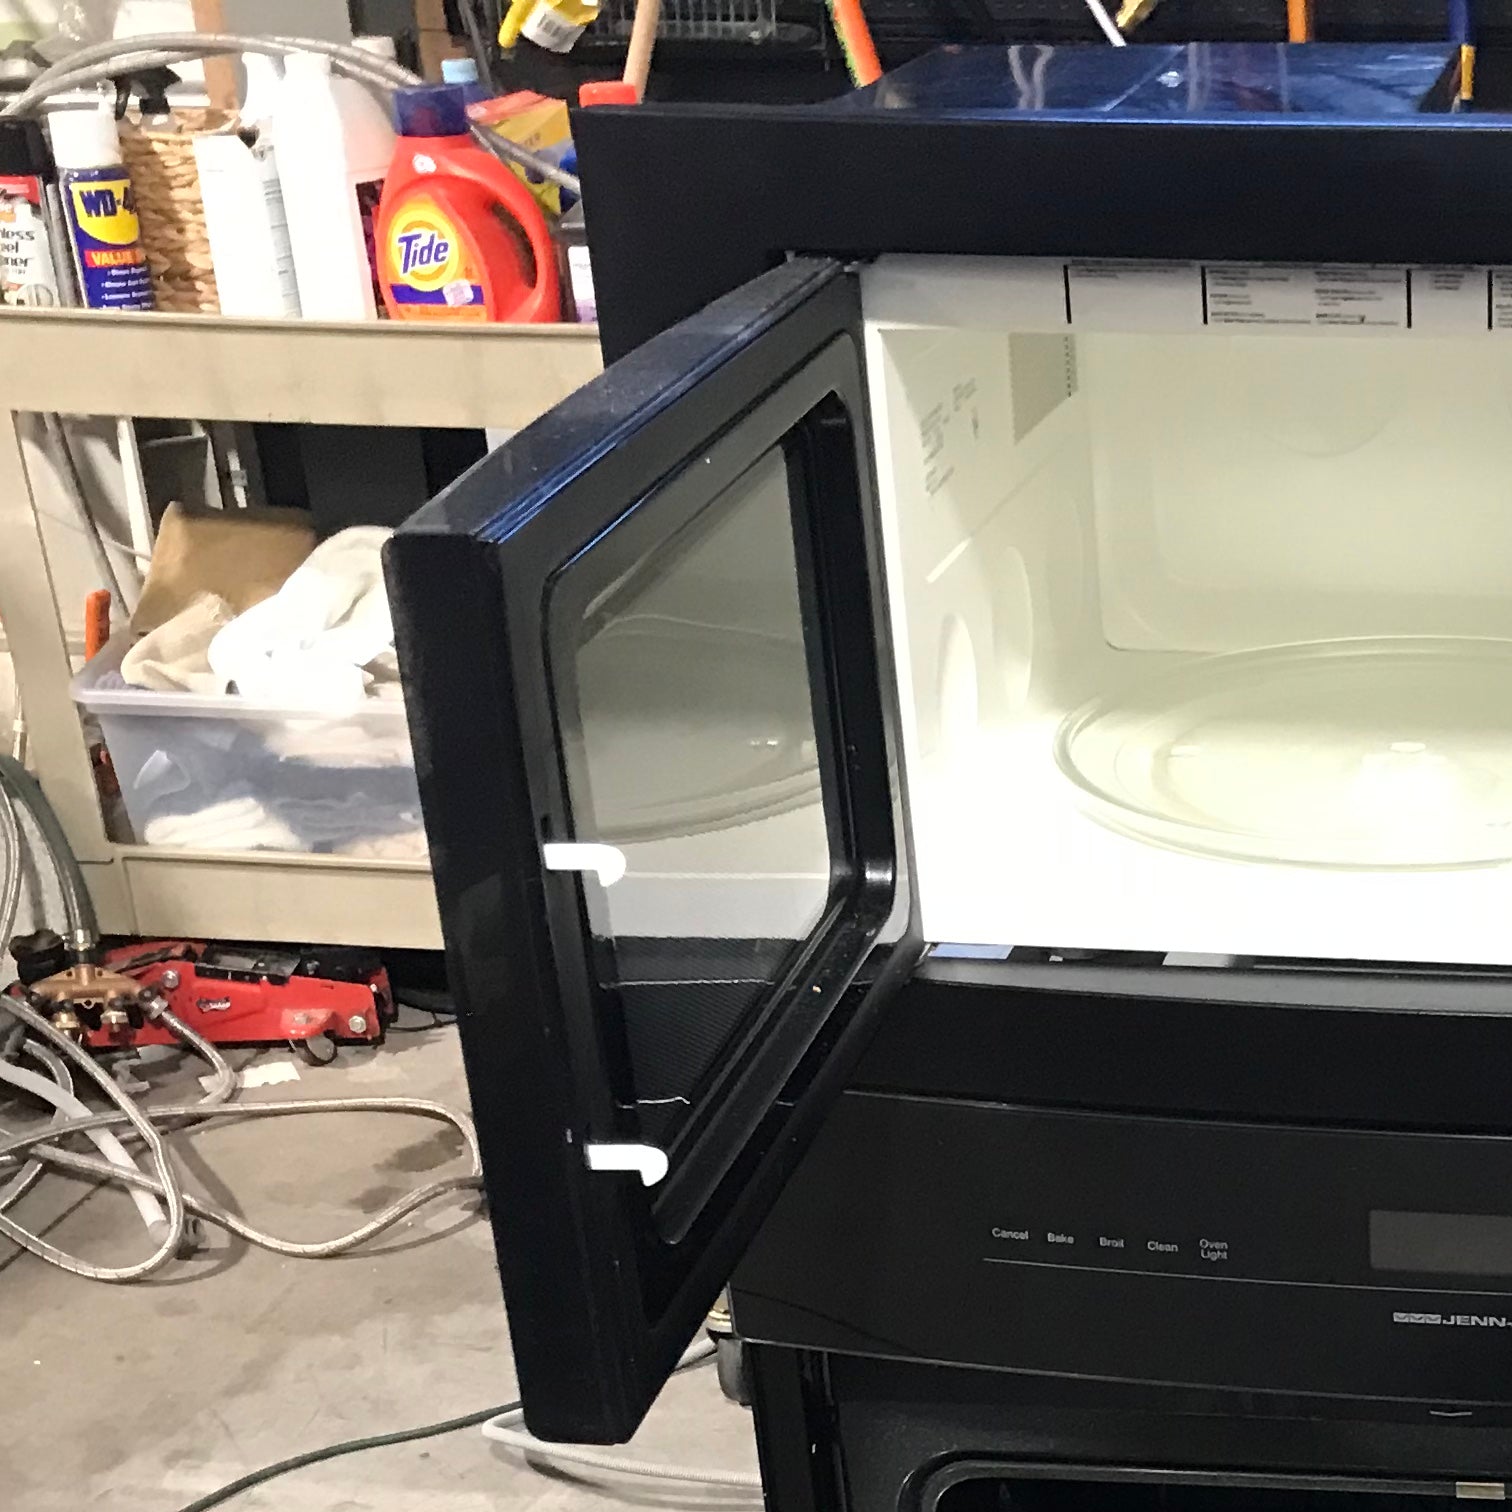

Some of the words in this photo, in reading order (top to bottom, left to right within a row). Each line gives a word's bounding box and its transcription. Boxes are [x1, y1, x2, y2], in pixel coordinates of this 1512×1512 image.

[398, 232, 449, 274] Tide
[992, 1228, 1028, 1239] Cancel
[1048, 1233, 1073, 1243] Bake
[1100, 1237, 1124, 1247] Broil
[1148, 1241, 1178, 1252] Clean
[1200, 1239, 1228, 1250] Oven
[1201, 1249, 1227, 1261] Light
